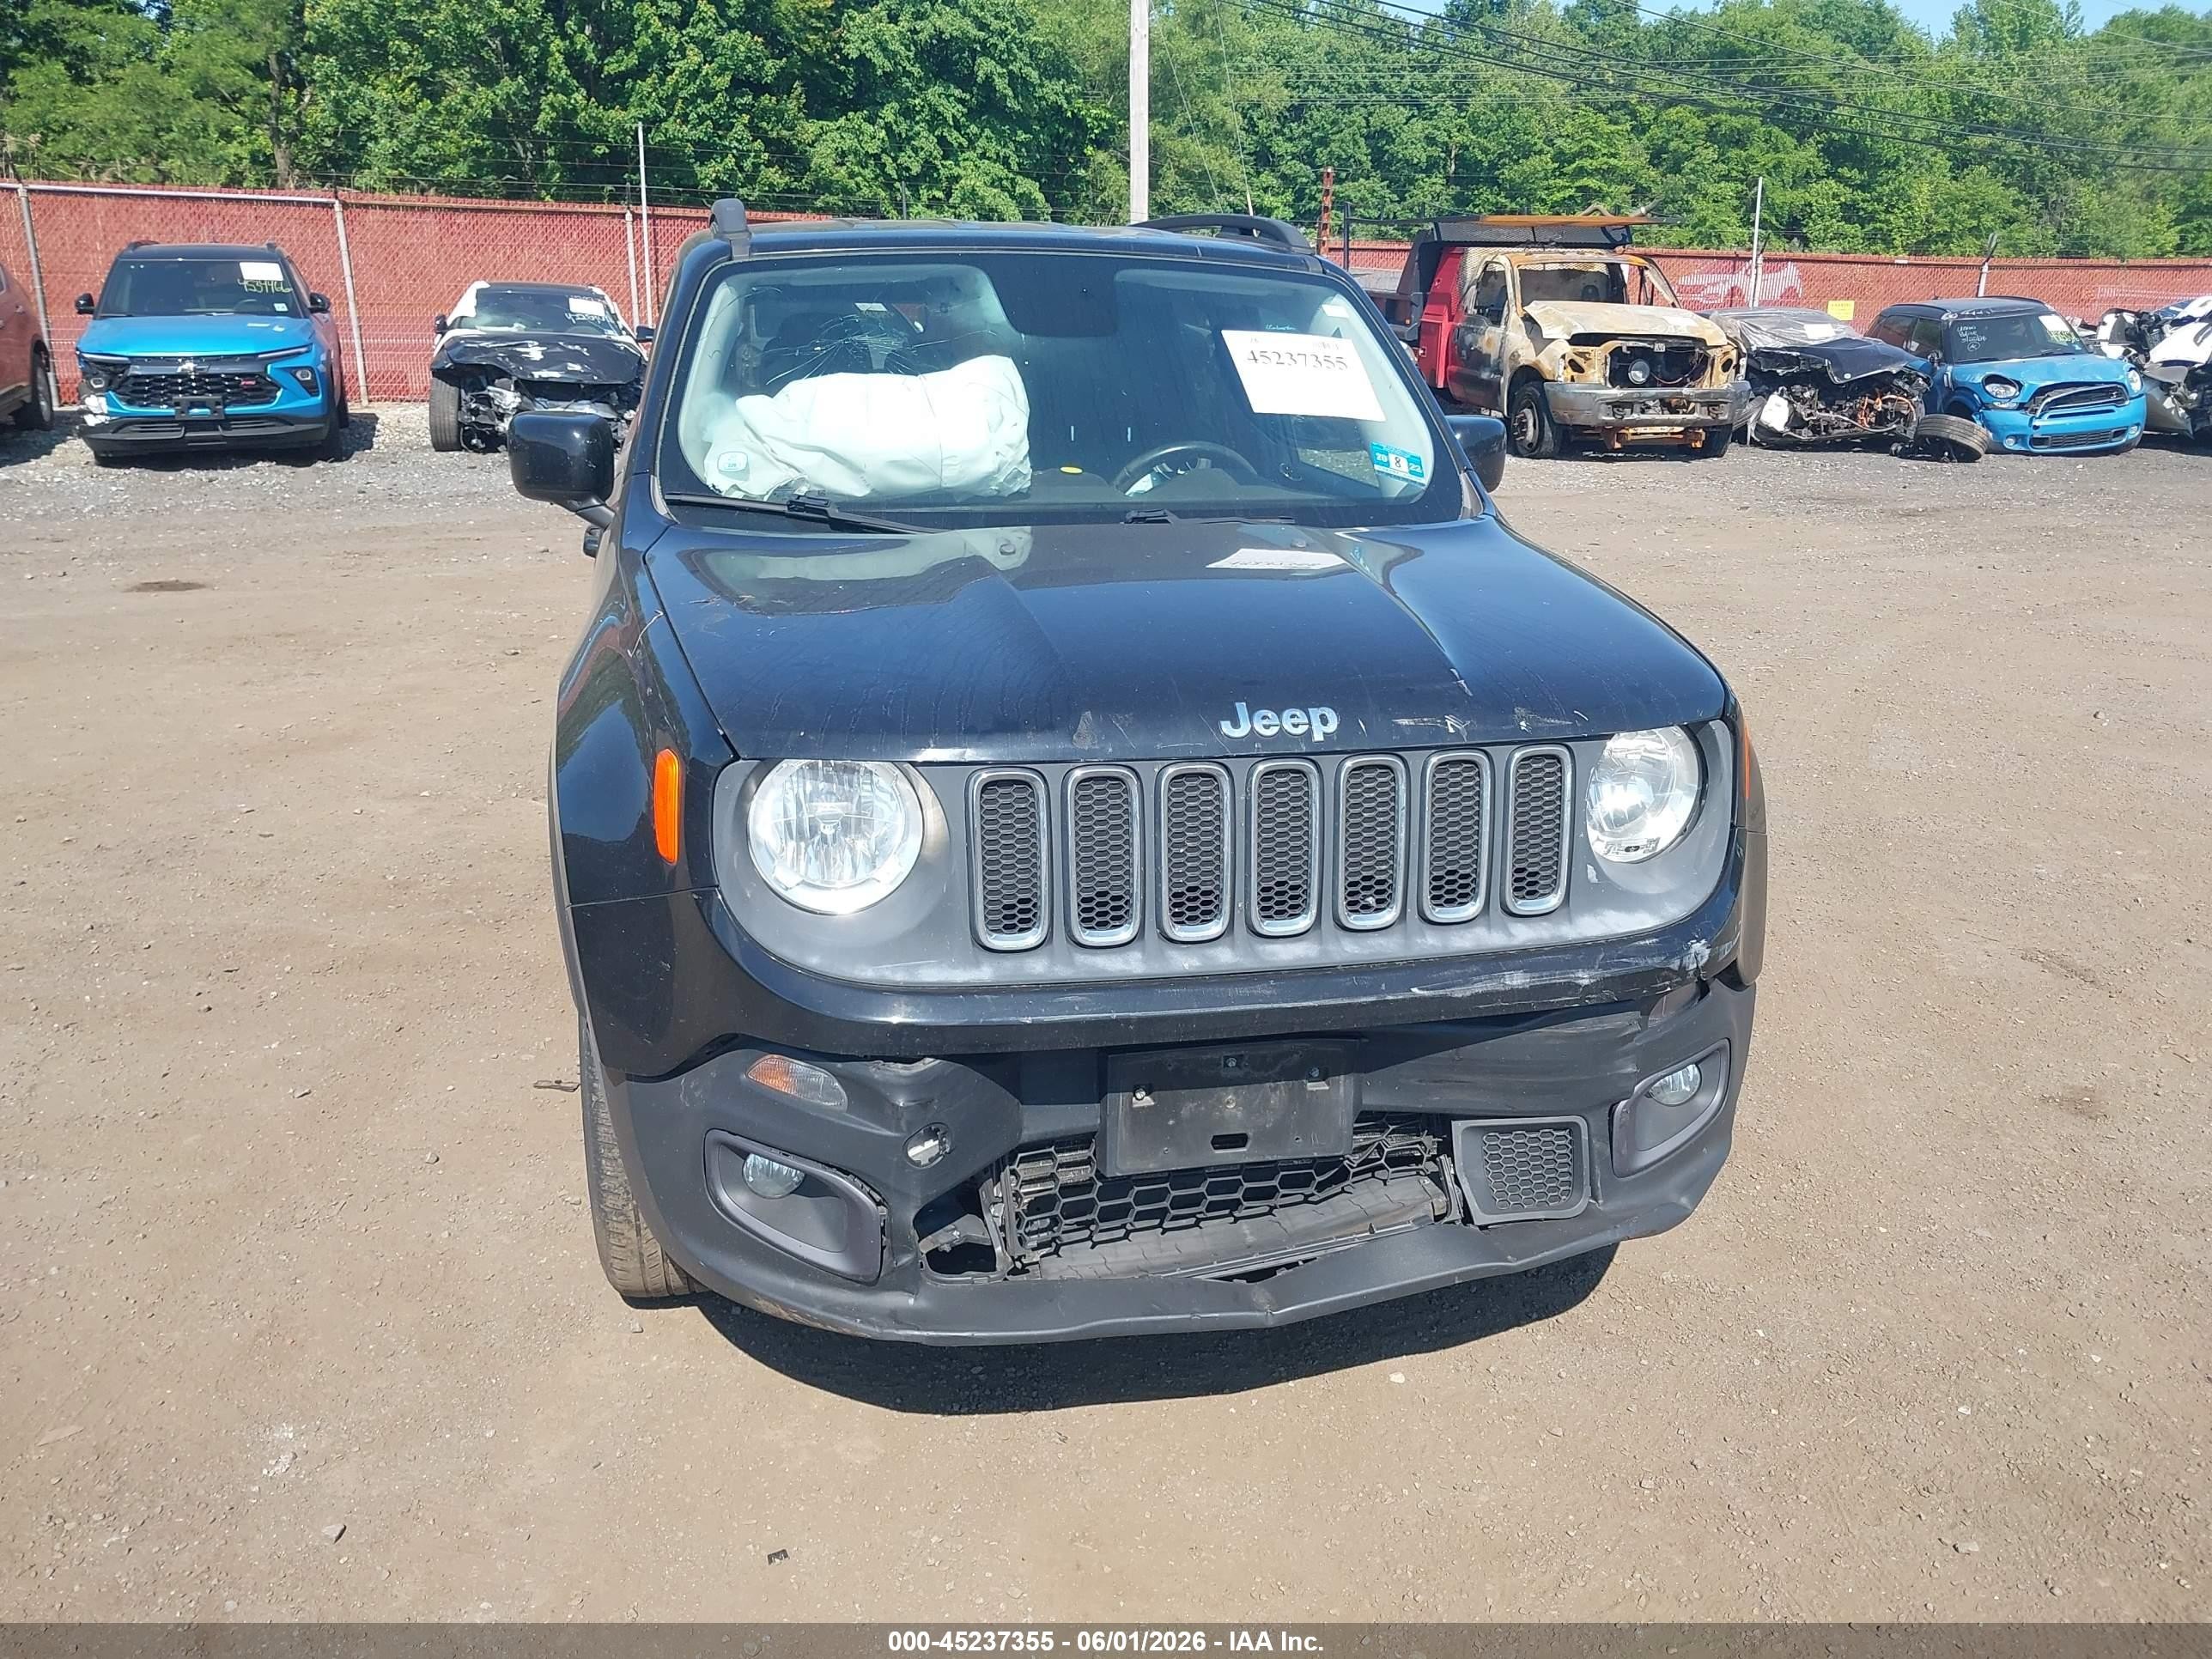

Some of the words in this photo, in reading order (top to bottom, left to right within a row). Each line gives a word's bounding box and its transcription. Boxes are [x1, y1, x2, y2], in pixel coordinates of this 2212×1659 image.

[1247, 349, 1348, 371] 45237355
[1395, 456, 1401, 468] 8
[1219, 702, 1339, 743] Jeep
